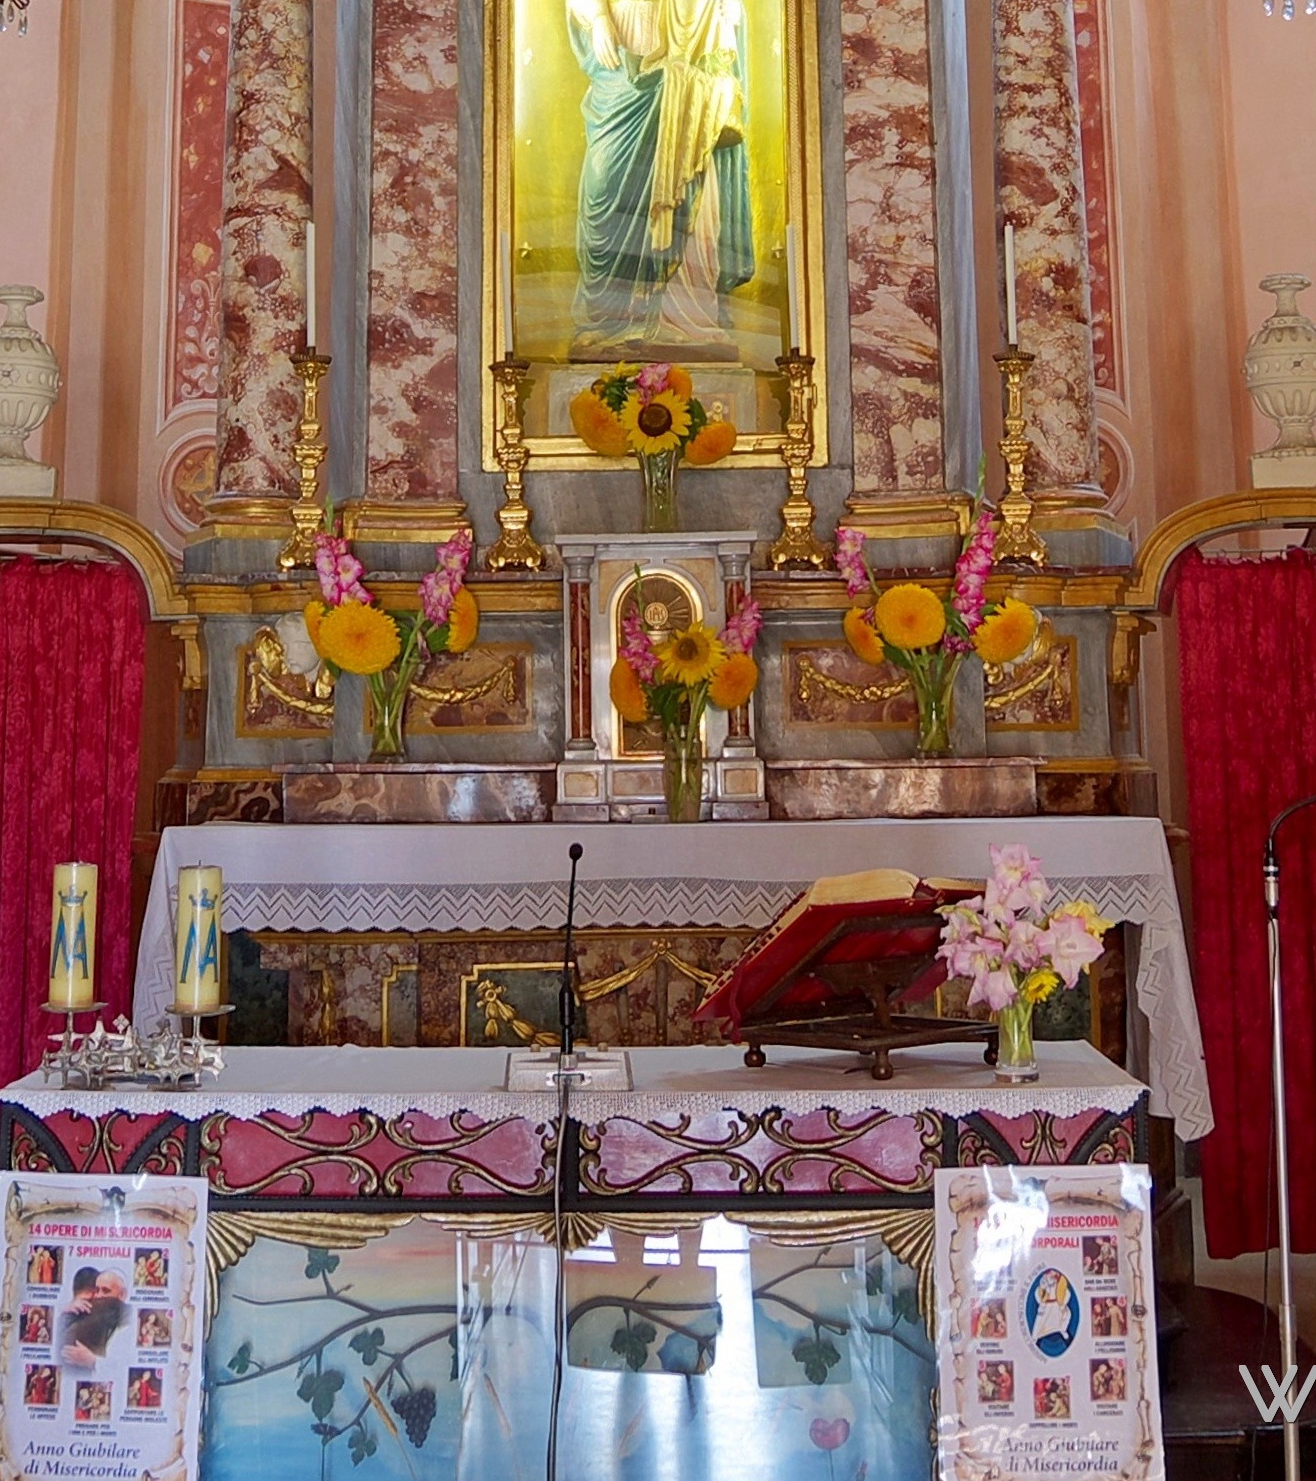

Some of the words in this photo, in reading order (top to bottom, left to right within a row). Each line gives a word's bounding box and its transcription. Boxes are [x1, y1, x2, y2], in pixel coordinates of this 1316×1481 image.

[28, 1224, 40, 1234] 14
[44, 1224, 77, 1237] OPERE
[81, 1226, 91, 1237] DI
[1110, 1236, 1117, 1246] 2
[68, 1246, 73, 1256] 7
[76, 1246, 131, 1257] SPIRITUALI
[162, 1249, 170, 1259] 2
[1117, 1296, 1125, 1306] 4
[166, 1309, 173, 1318] 4
[23, 1441, 65, 1457] Anno
[69, 1442, 141, 1459] Giubilare
[24, 1459, 39, 1474] di
[44, 1461, 137, 1478] Misericordia
[1022, 1456, 1118, 1472] Misericordia
